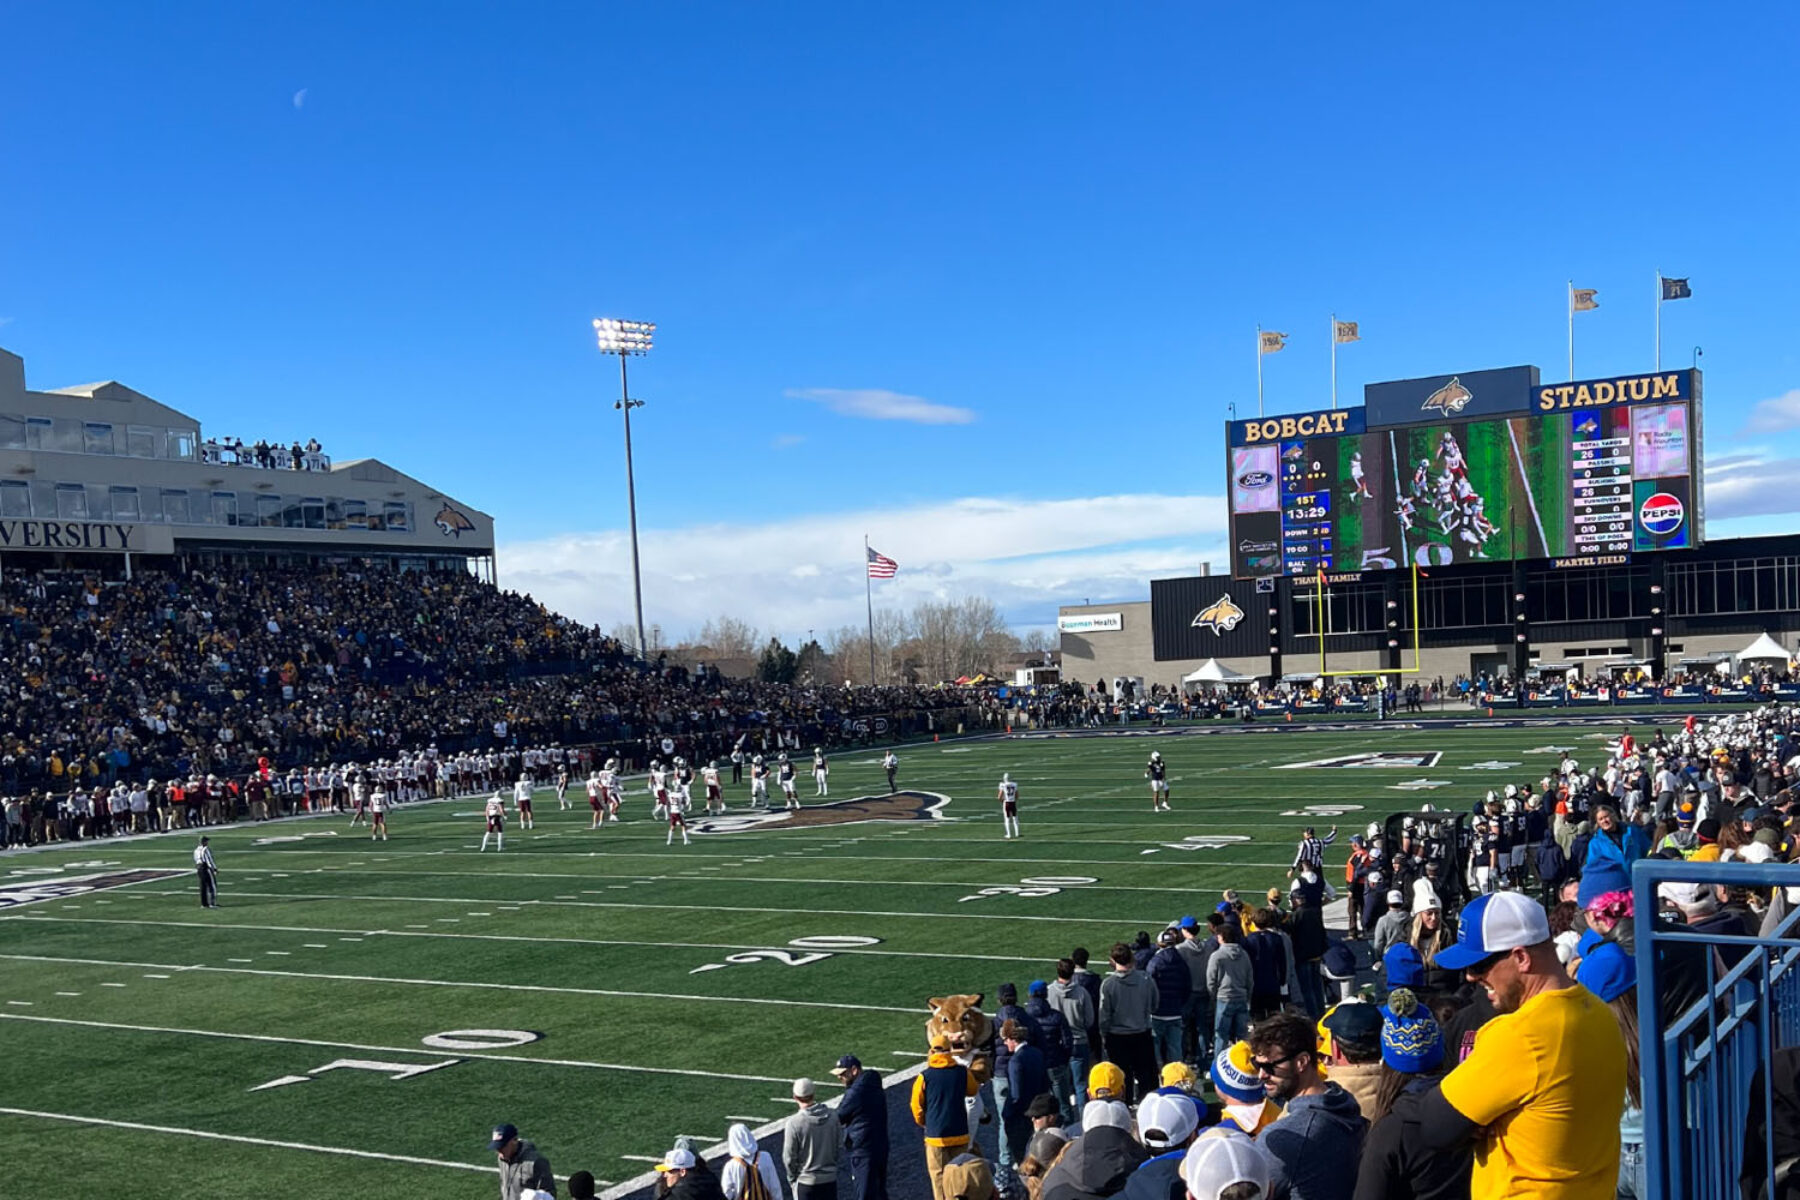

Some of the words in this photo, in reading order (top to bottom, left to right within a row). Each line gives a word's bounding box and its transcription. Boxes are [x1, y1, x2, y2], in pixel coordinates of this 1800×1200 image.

[1540, 374, 1680, 411] STADIUM
[1245, 411, 1348, 443] BOBCAT
[1312, 461, 1321, 471] 0
[1245, 474, 1268, 485] Ford
[1296, 495, 1316, 505] 1ST
[1287, 507, 1326, 519] 13:29
[1643, 508, 1681, 518] PEPSI
[0, 521, 133, 548] VERSITY
[1555, 558, 1596, 568] MARTEL
[1597, 555, 1627, 565] FIELD
[1328, 573, 1362, 583] FAMILY
